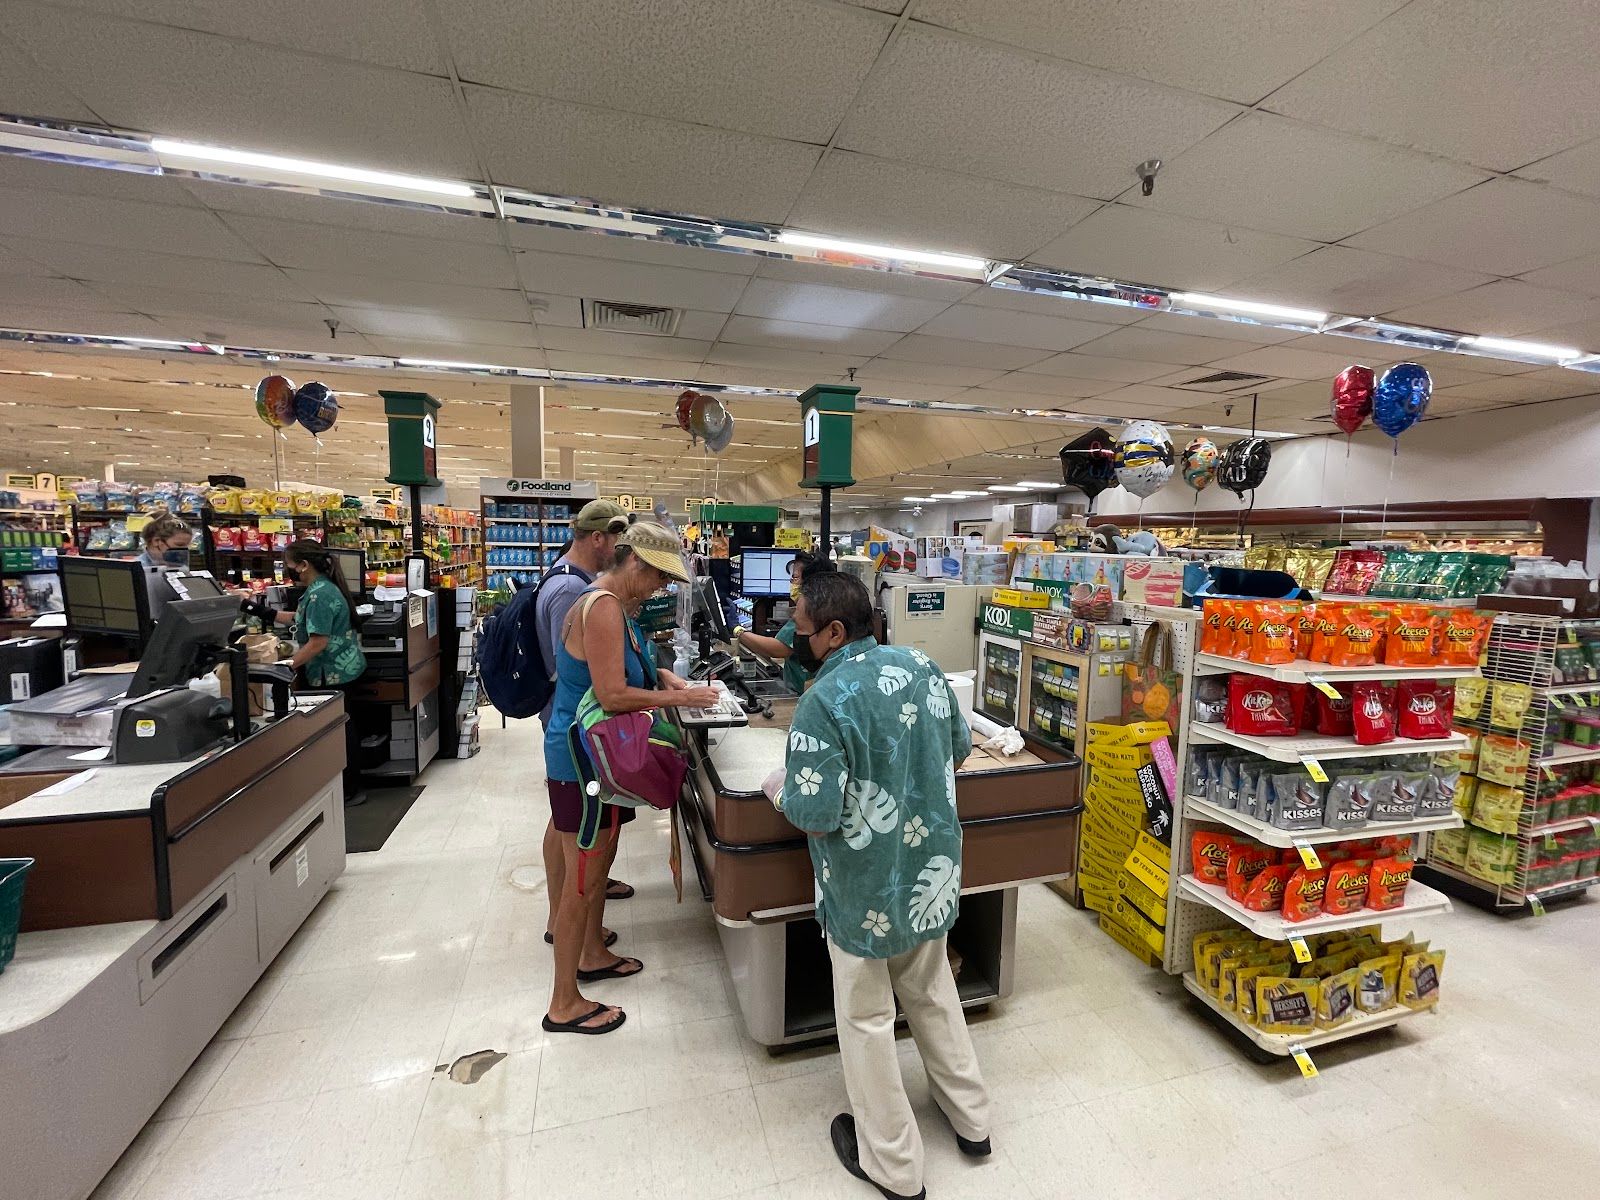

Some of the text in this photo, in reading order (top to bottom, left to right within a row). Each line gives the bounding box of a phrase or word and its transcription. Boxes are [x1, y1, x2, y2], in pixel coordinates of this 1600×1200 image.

[426, 418, 432, 443] 2
[810, 414, 815, 441] 1
[42, 477, 51, 488] 7
[521, 481, 571, 491] Foodland
[623, 498, 629, 507] 3
[984, 605, 1013, 628] KOOL
[1340, 623, 1373, 638] Reese's
[1393, 623, 1429, 636] Reese's
[1402, 641, 1426, 653] THINS
[1143, 766, 1153, 794] WATER
[1146, 764, 1160, 800] COCONUT
[1138, 769, 1153, 808] ESPRESSO
[1139, 862, 1154, 876] YERBA
[1273, 996, 1306, 1012] HERSHEY'S
